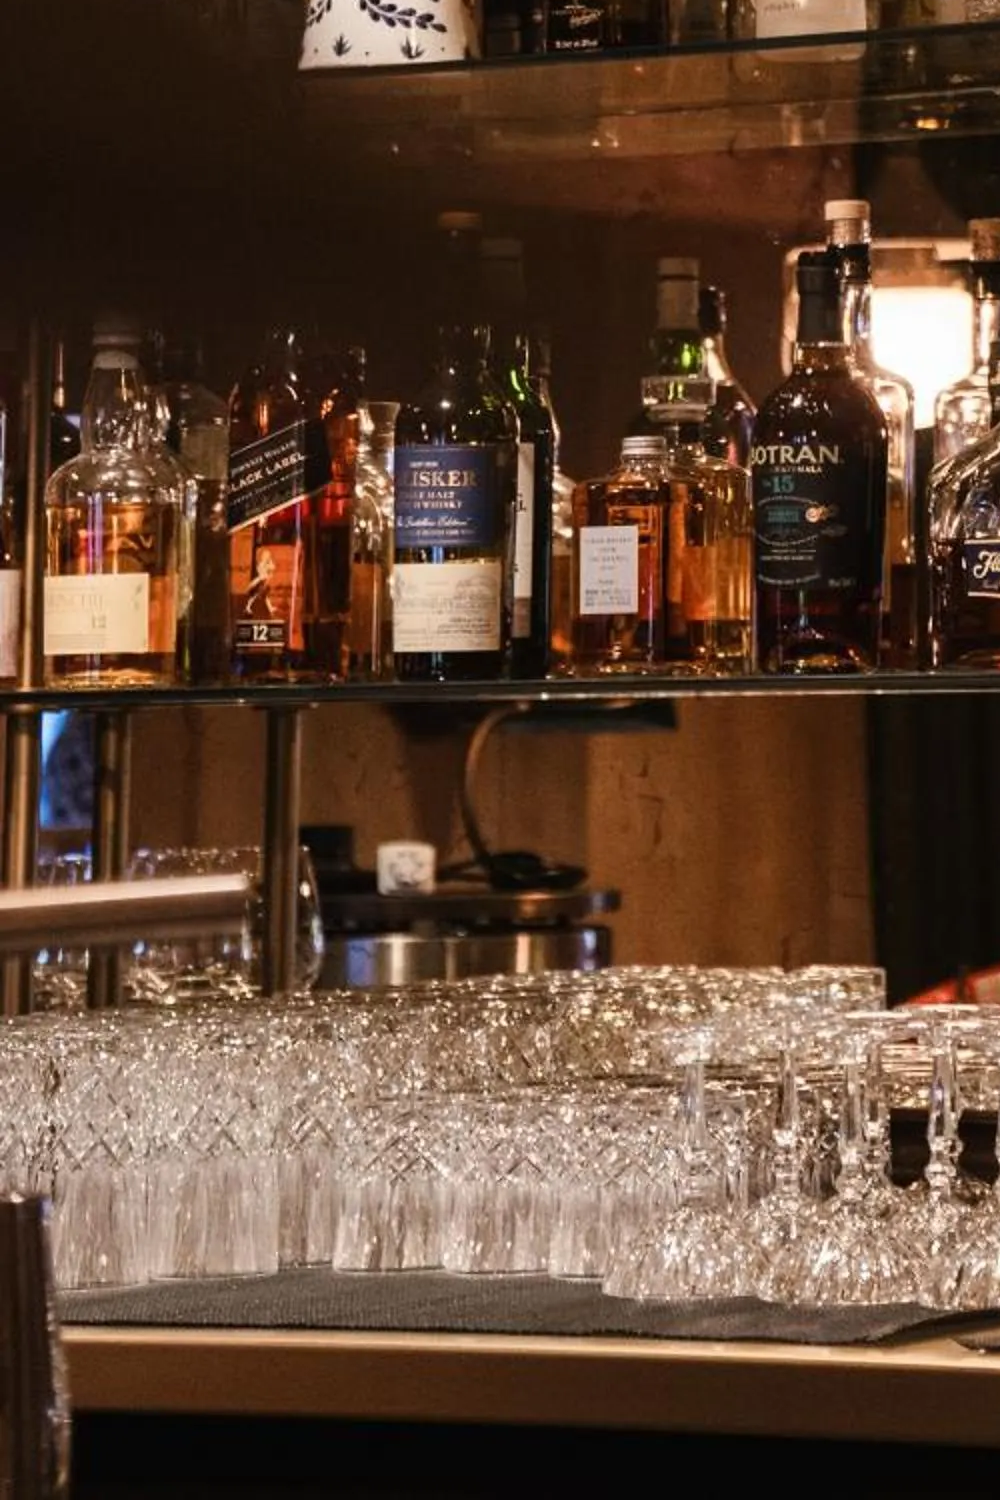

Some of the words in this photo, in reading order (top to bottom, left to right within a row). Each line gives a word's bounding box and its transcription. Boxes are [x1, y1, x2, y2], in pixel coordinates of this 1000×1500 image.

[228, 469, 263, 493] LACK
[265, 451, 305, 475] LABEL
[252, 624, 269, 642] 12
